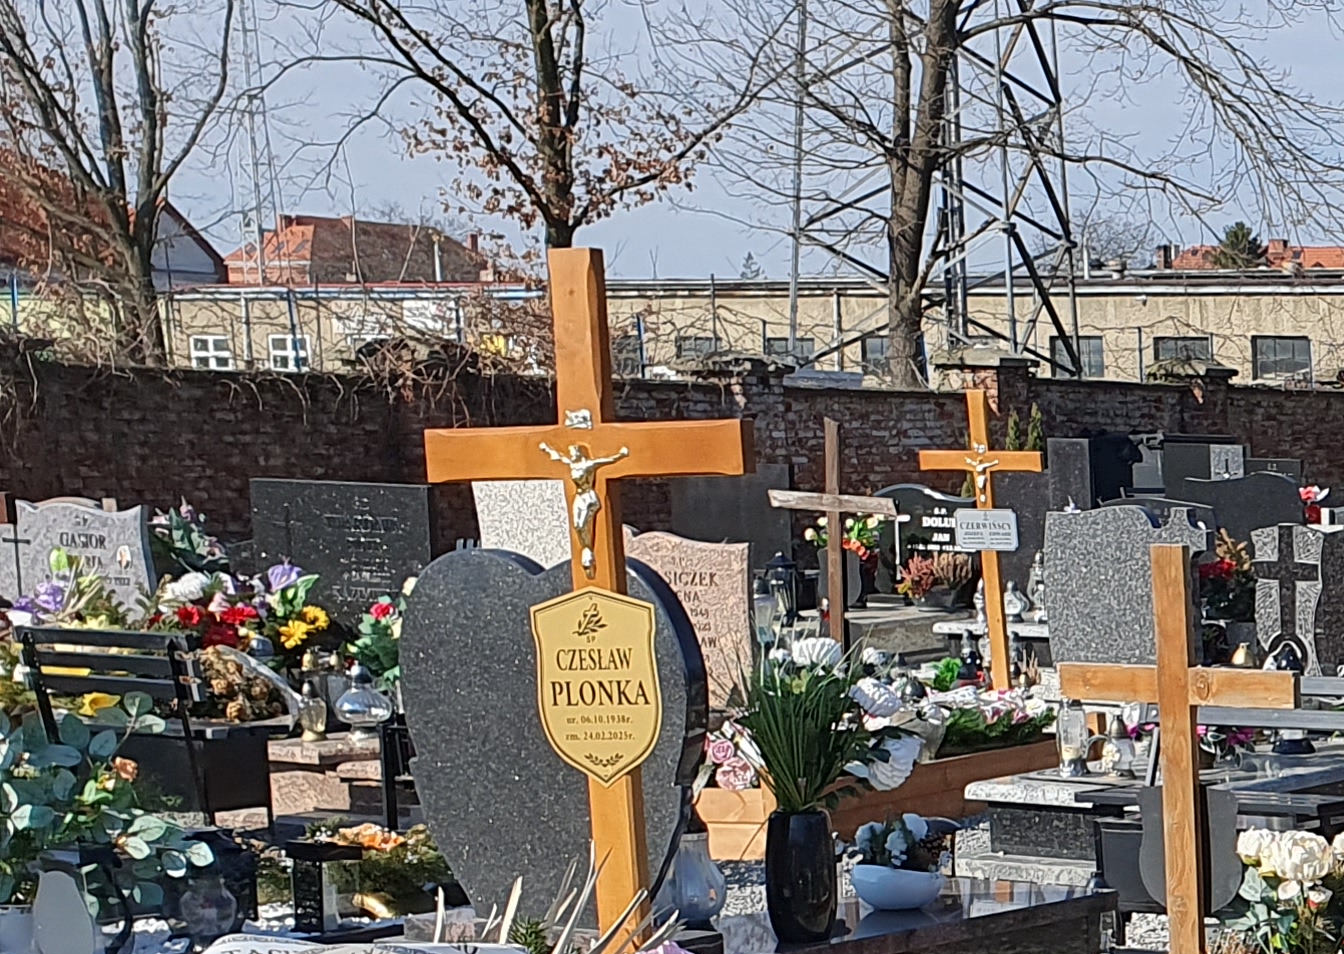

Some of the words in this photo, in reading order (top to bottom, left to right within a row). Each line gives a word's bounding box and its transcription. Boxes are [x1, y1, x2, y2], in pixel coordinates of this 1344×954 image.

[931, 532, 951, 542] JAN
[556, 647, 633, 672] CZESŁAW
[566, 717, 579, 725] ur.
[565, 732, 581, 741] zm.
